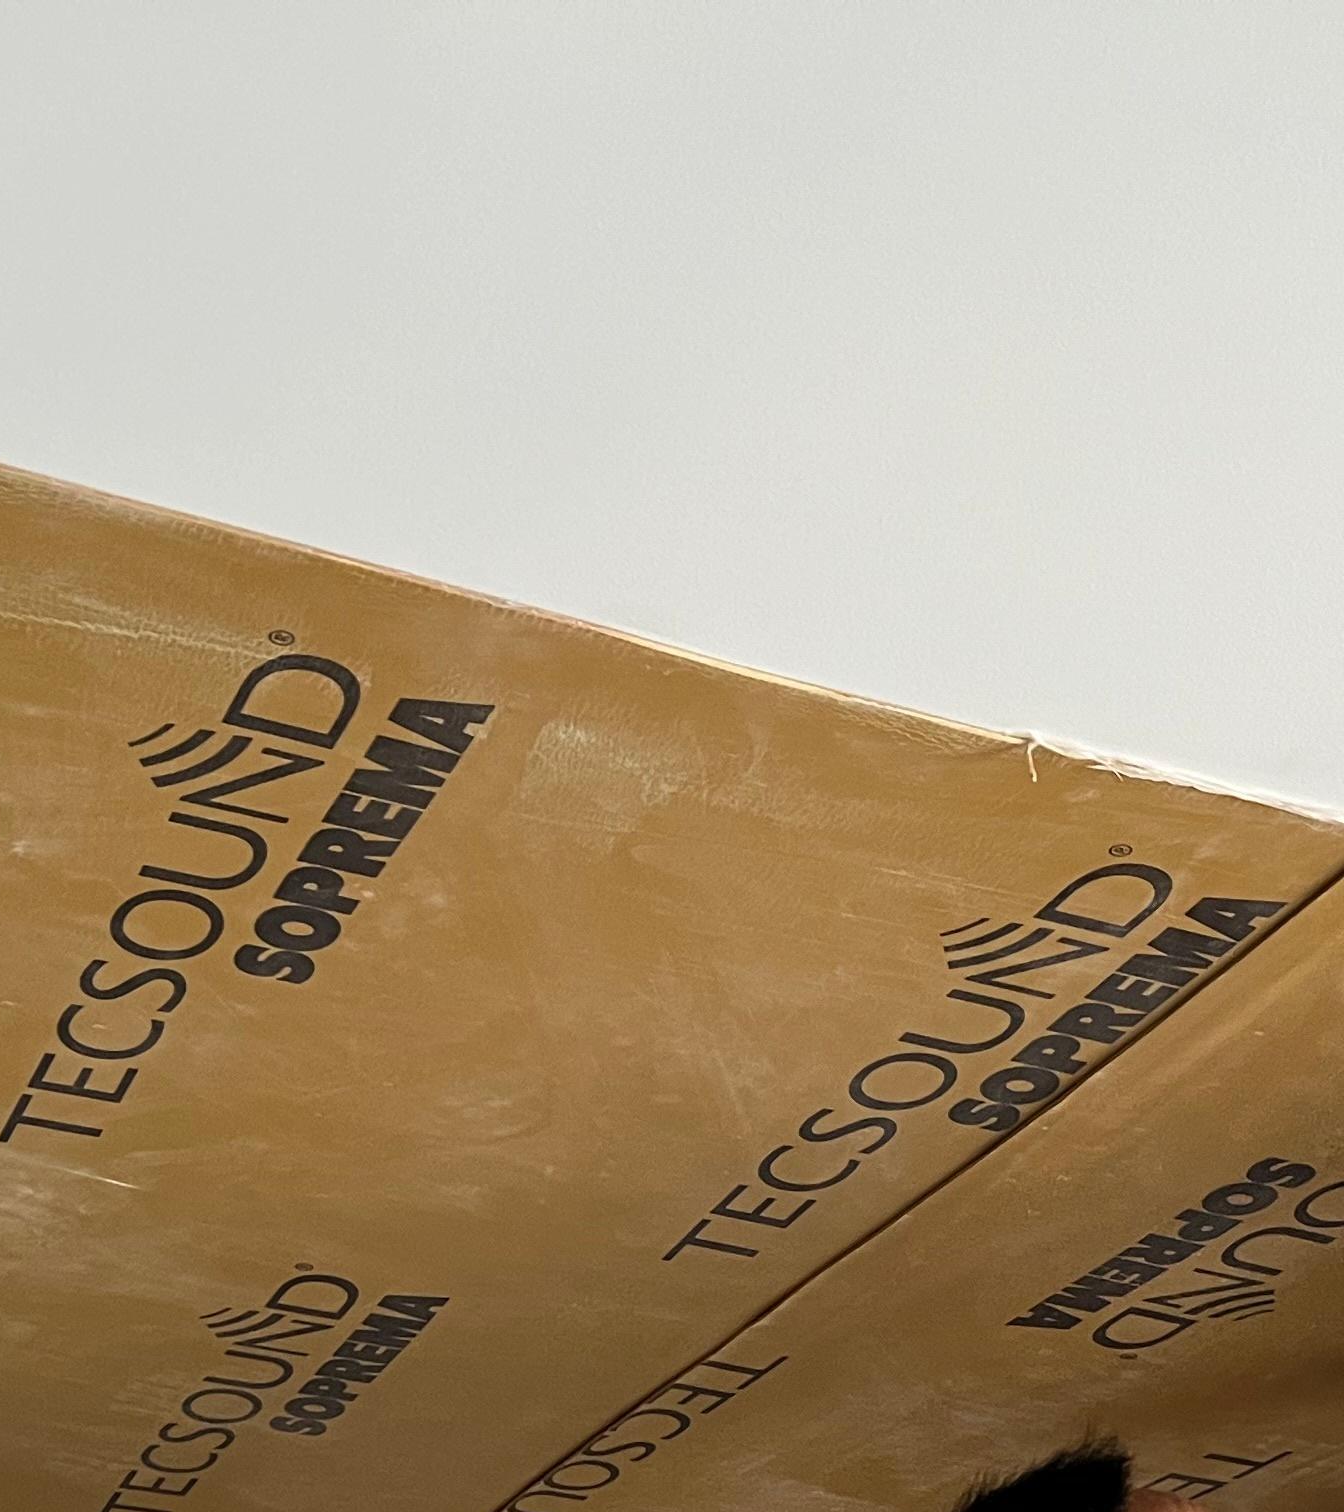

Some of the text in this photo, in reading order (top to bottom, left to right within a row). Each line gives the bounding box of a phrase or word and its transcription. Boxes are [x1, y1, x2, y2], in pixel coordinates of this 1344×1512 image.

[233, 697, 495, 985] SOPREMA
[662, 863, 1174, 1263] TECSOUND
[947, 896, 1288, 1132] SOPREMA
[1006, 1156, 1317, 1331] SOPREMA
[268, 1293, 451, 1437] SOPREMA
